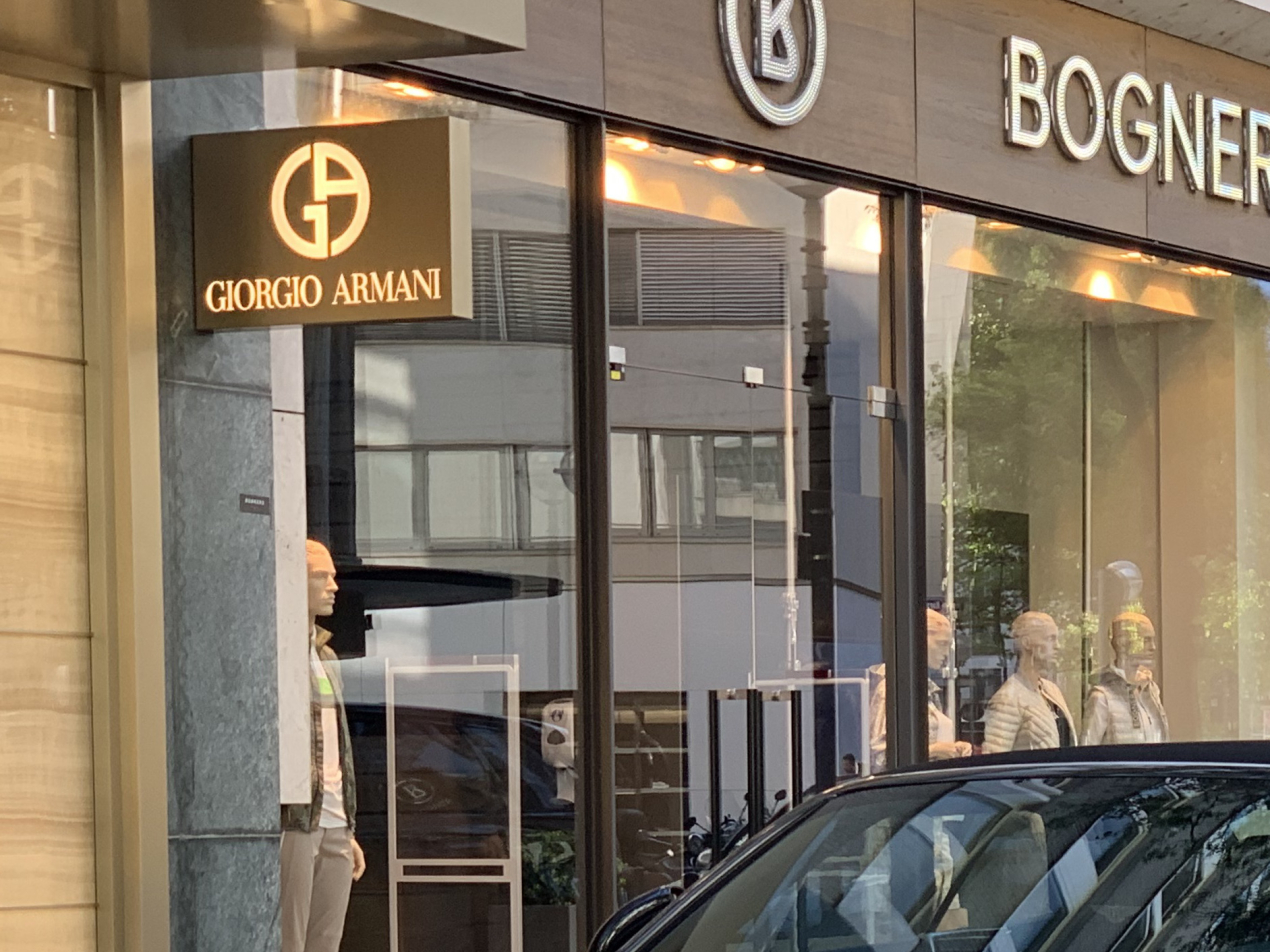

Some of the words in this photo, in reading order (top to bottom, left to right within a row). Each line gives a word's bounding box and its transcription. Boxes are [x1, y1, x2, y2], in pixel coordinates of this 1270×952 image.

[1004, 35, 1270, 214] BOGNER
[205, 274, 323, 313] GIORGIO
[332, 268, 442, 305] ARMANI
